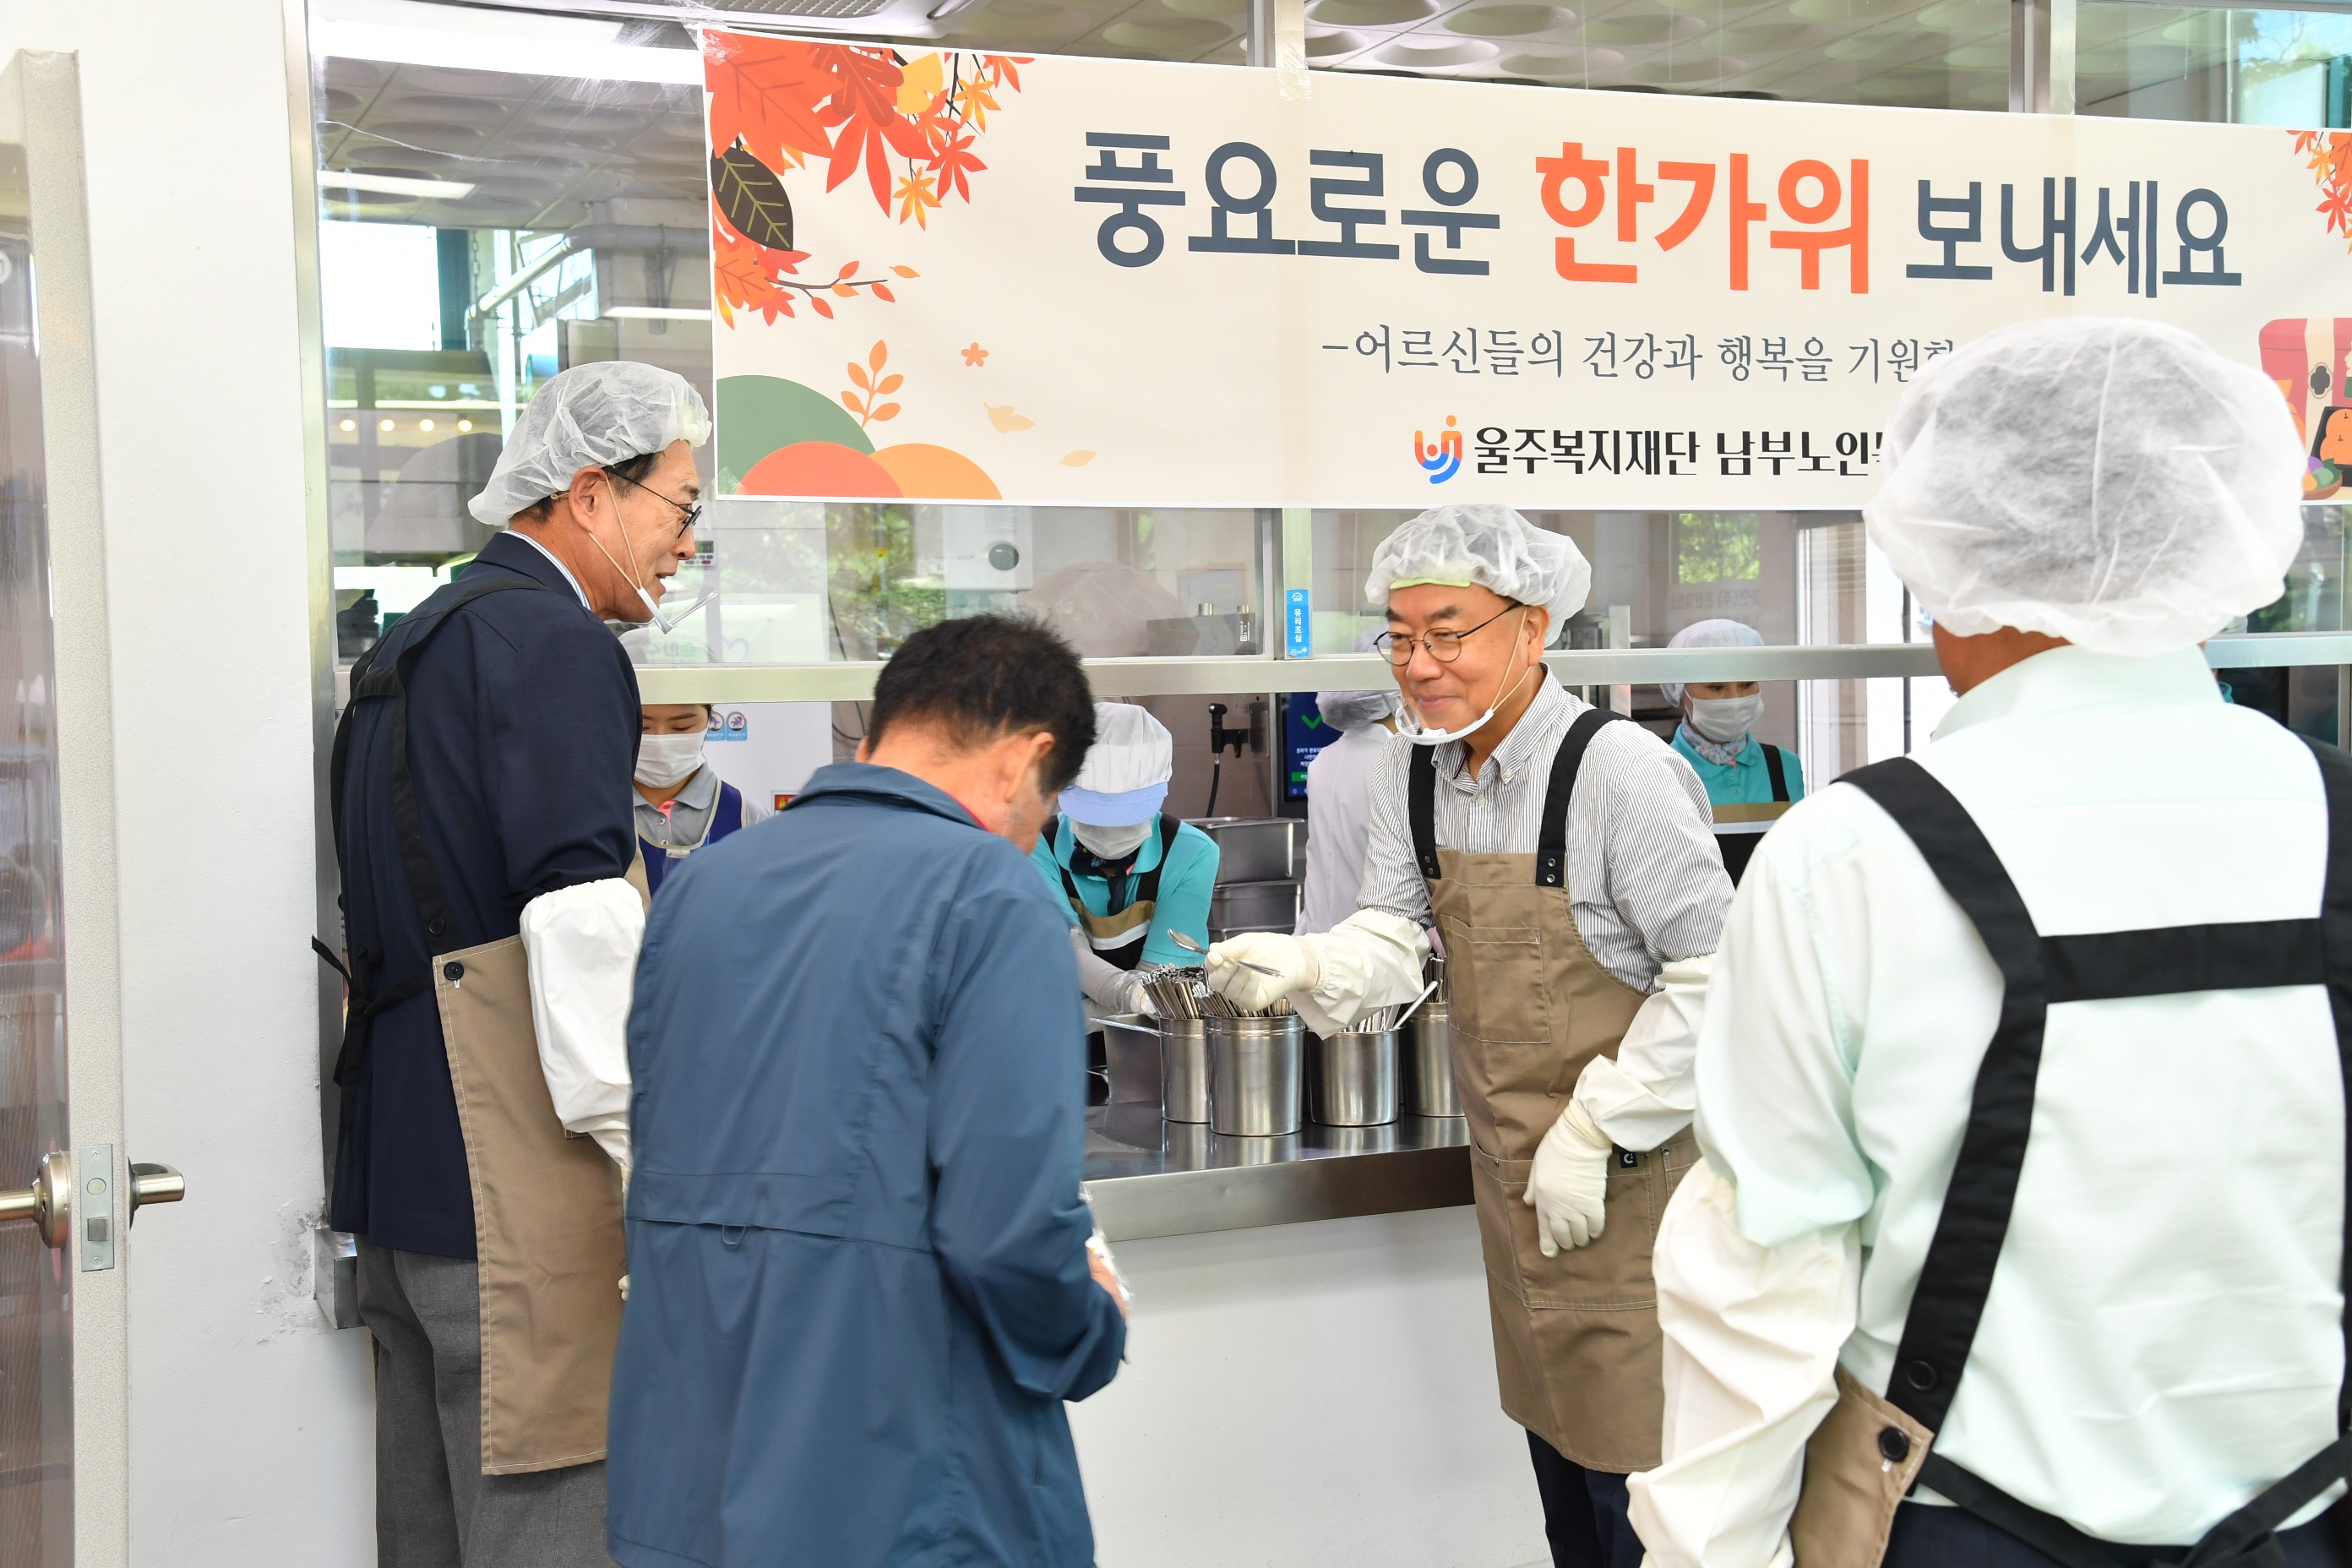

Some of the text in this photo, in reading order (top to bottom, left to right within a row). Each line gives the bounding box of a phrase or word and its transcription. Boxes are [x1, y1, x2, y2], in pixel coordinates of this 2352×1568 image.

[1075, 132, 2242, 298] 풍요로운 한가위 보내세요
[1582, 332, 1703, 381] 건강과
[1718, 335, 1833, 383] 행복을
[1474, 427, 1883, 476] 울주복지재단 남부노인
[1293, 608, 1303, 643] 유리조심
